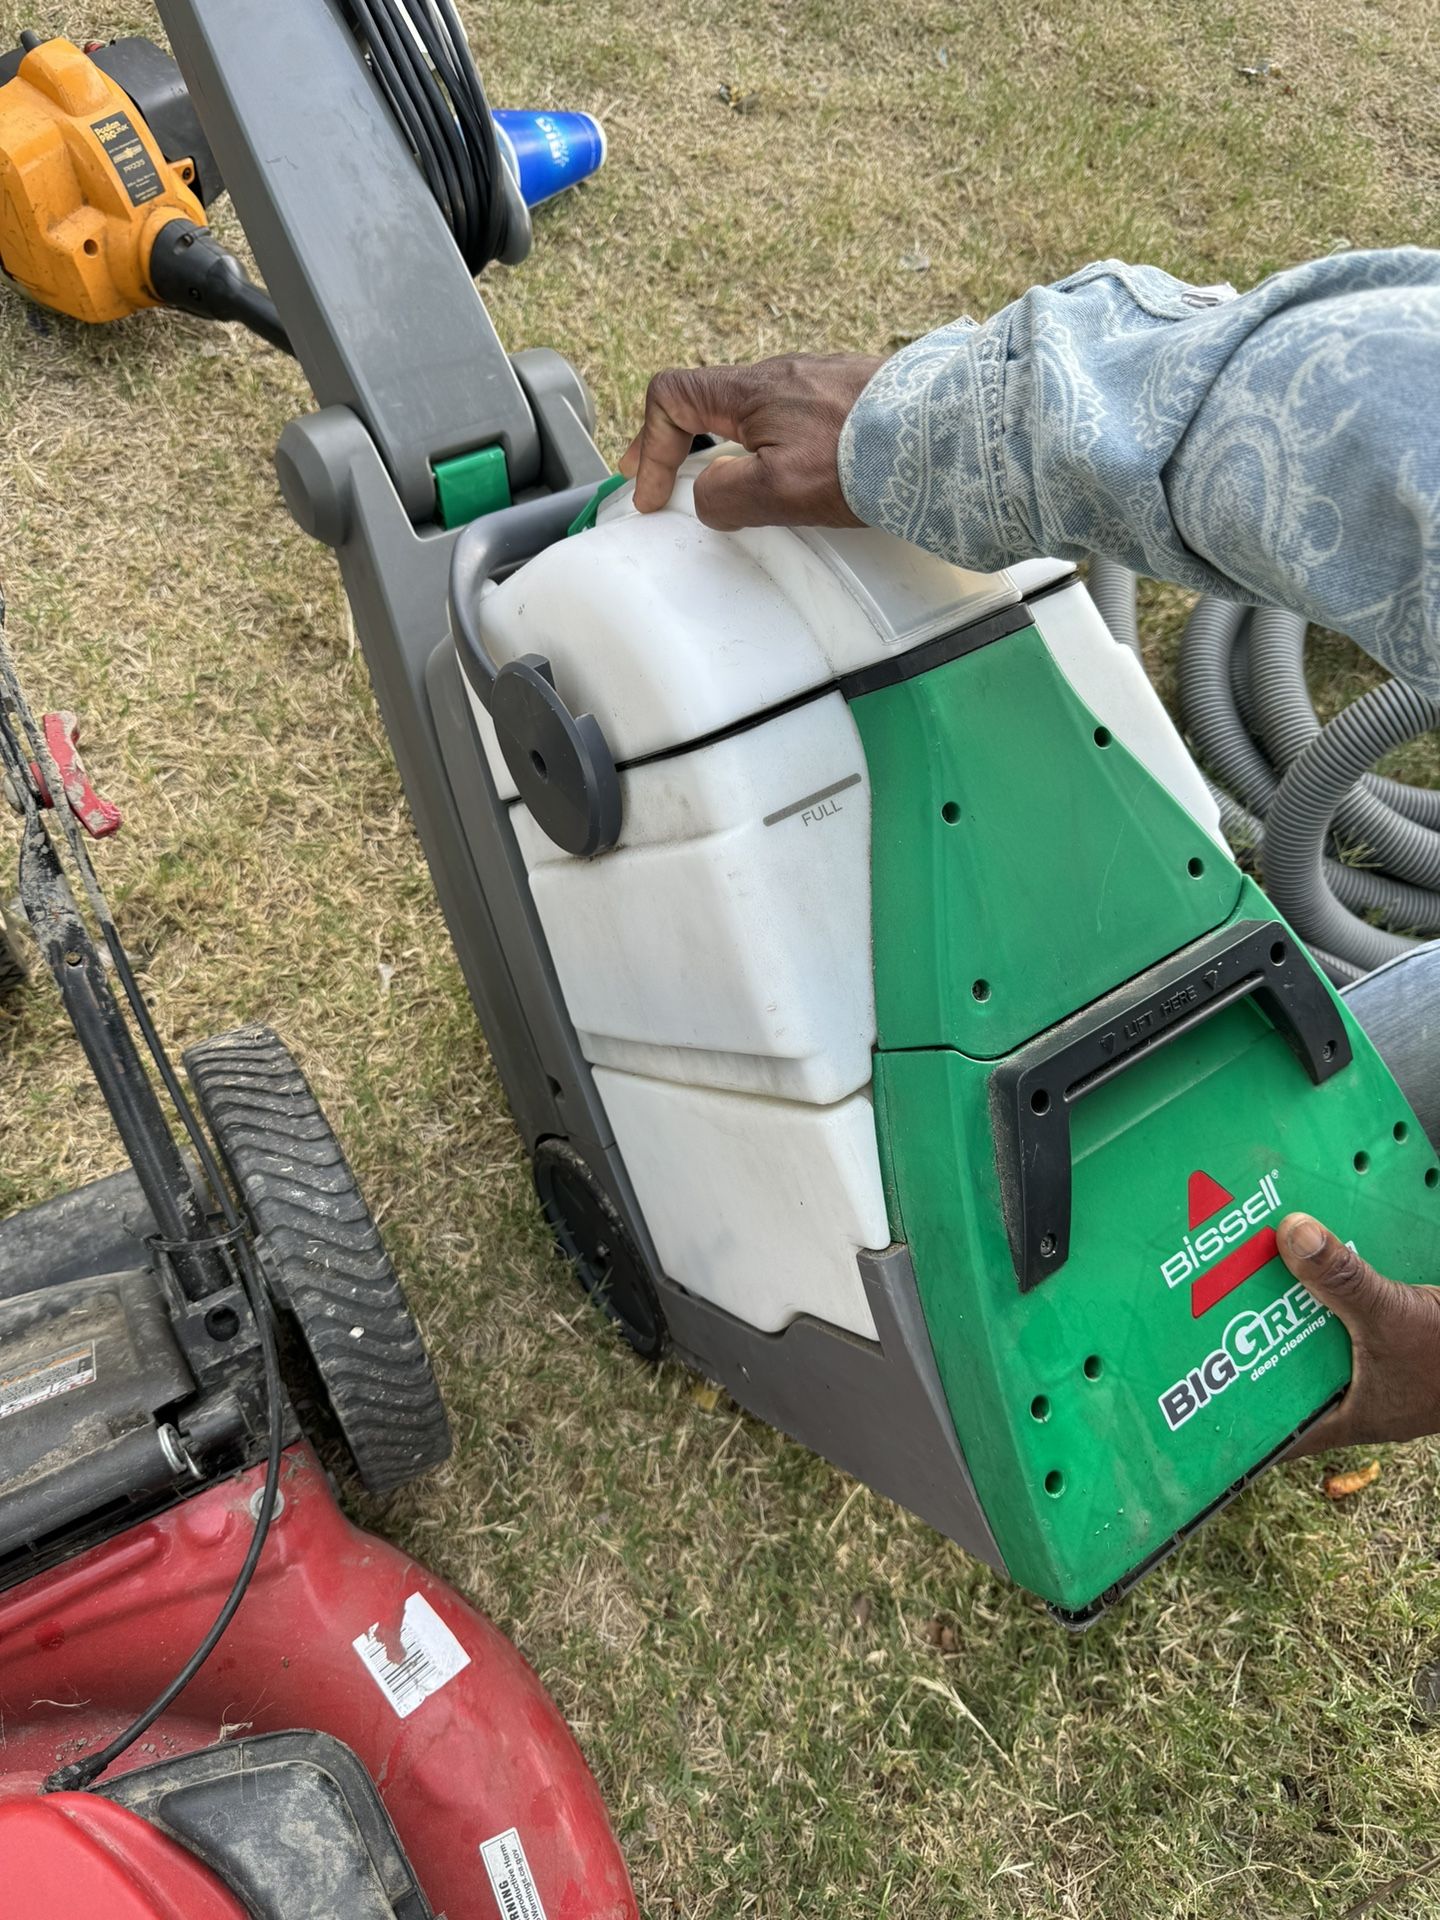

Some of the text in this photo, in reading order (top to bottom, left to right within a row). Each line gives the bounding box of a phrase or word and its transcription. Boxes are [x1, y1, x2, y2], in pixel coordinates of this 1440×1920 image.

[801, 800, 843, 827] FULL
[1124, 984, 1198, 1040] LIFT HERE
[1250, 1315, 1326, 1382] deep cleaning
[500, 1844, 512, 1869] Harm
[498, 1880, 521, 1920] RNING
[507, 1866, 531, 1920] eproductive
